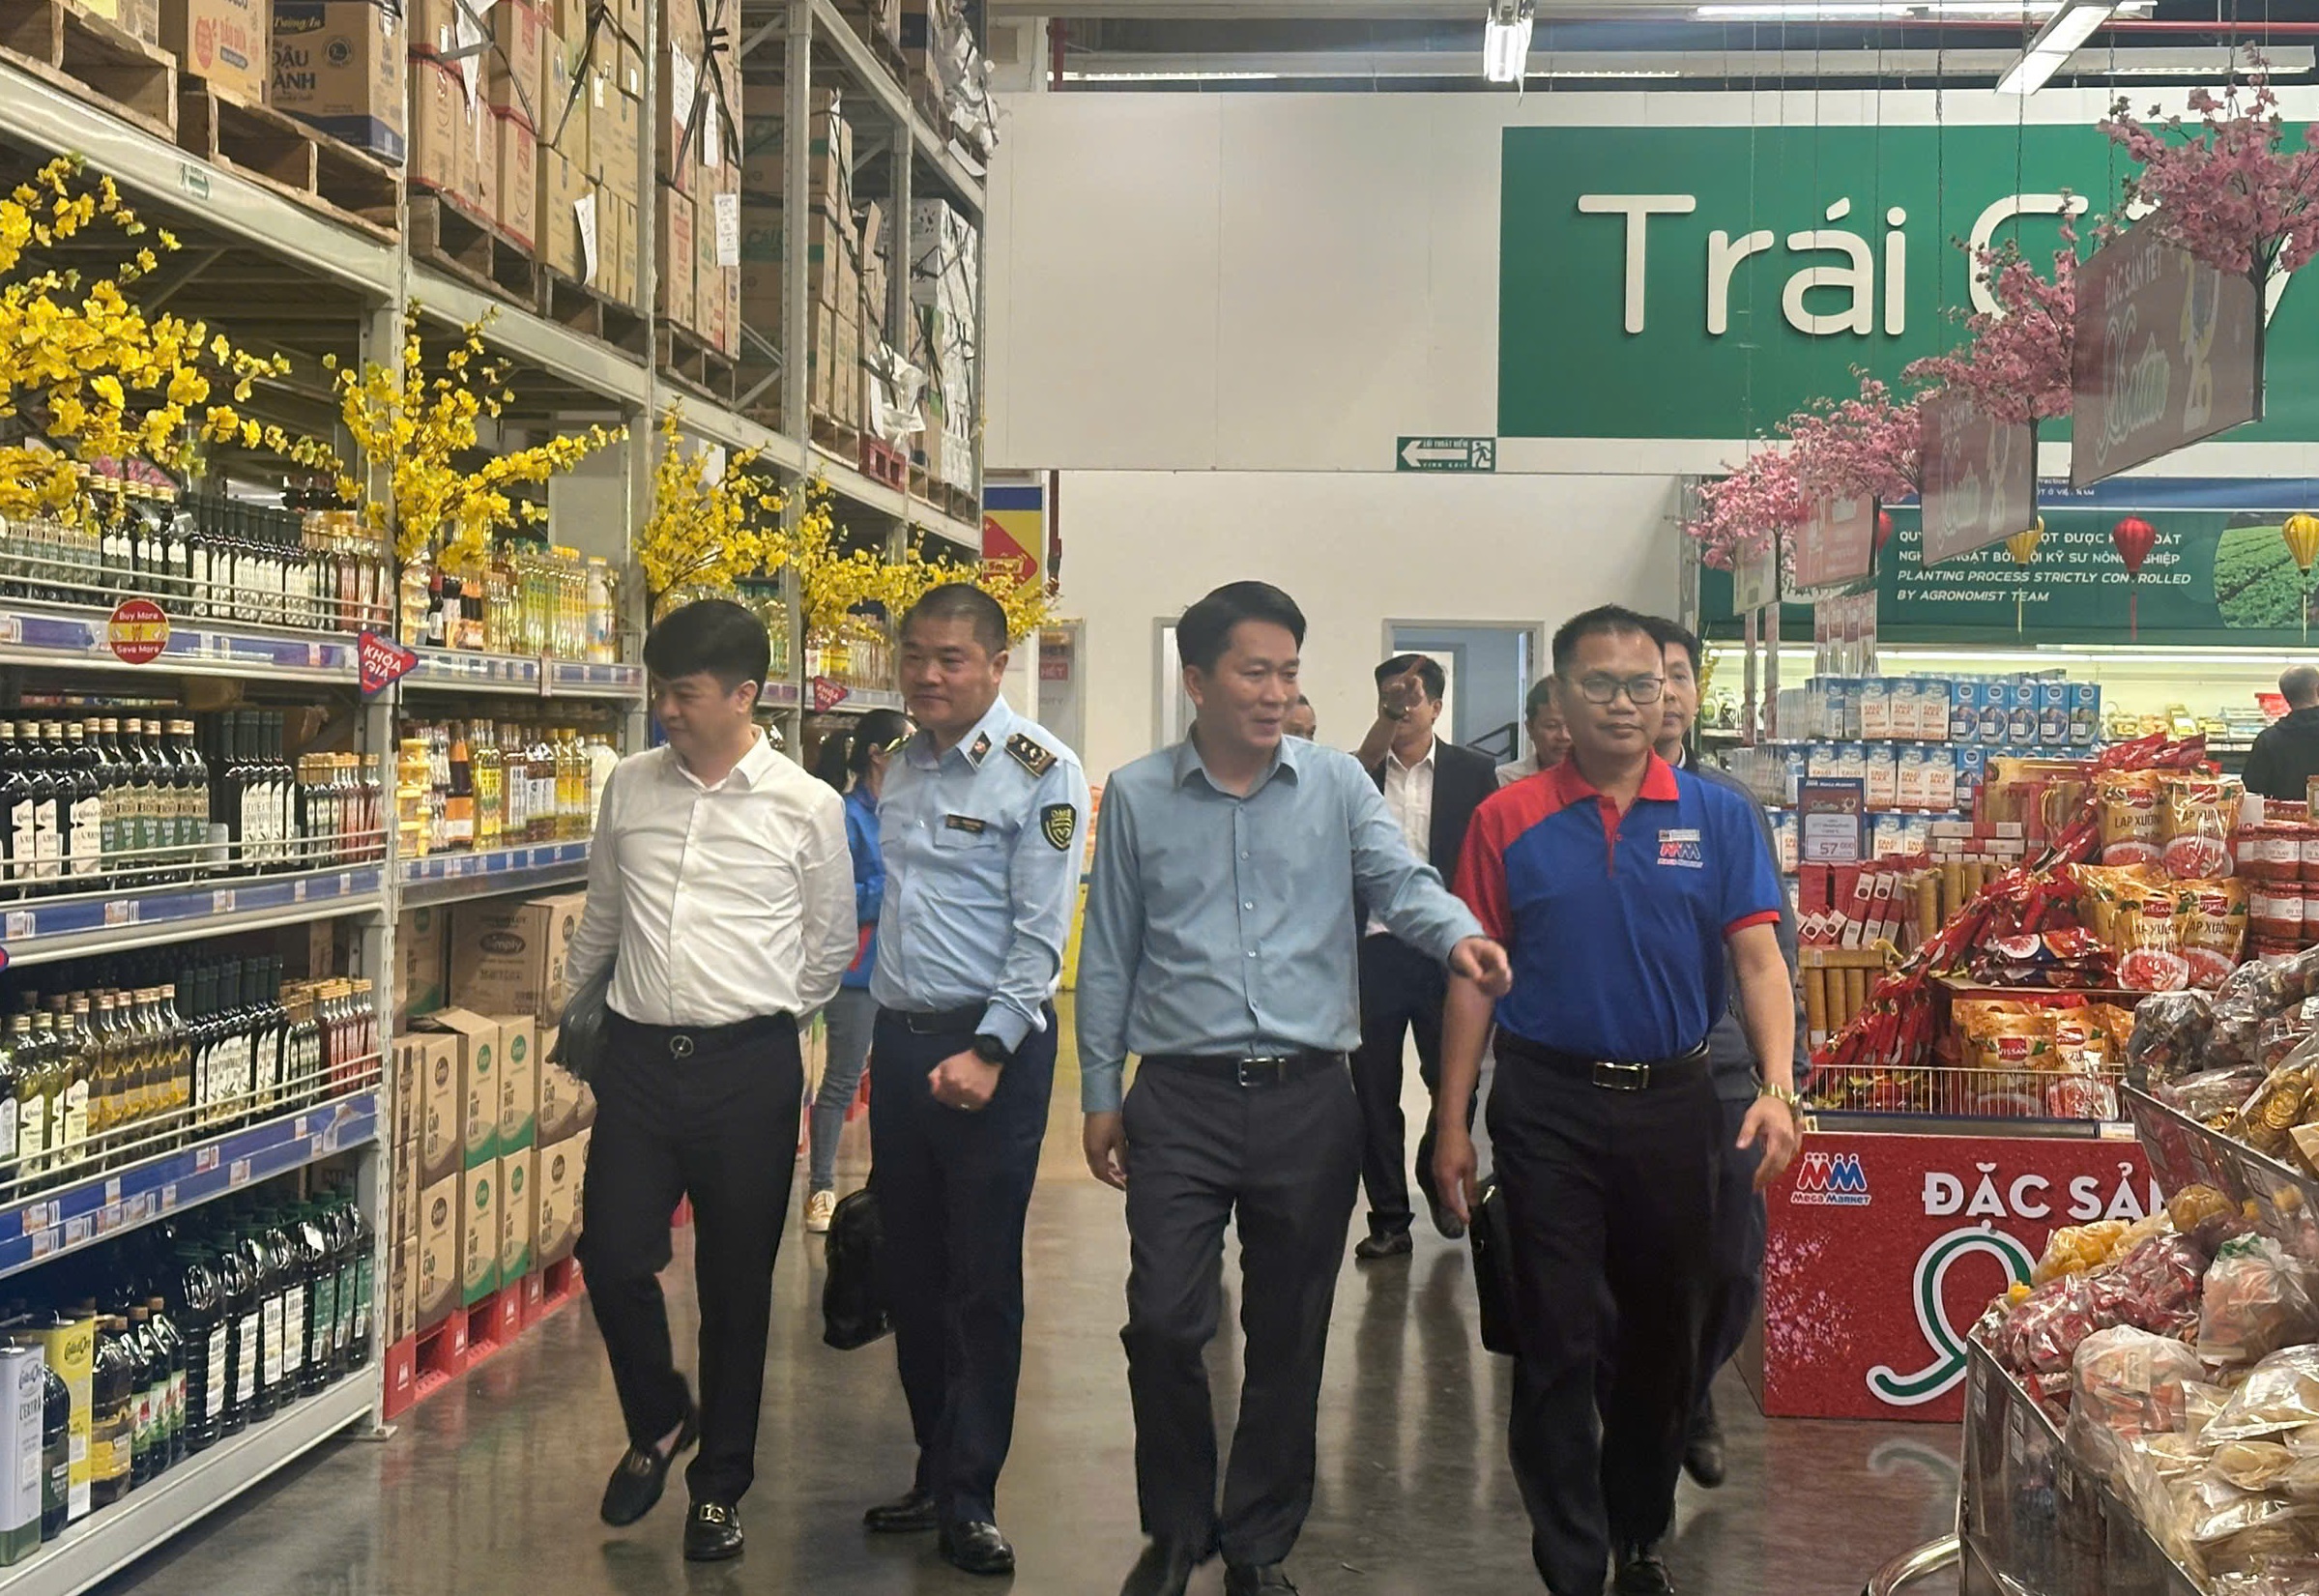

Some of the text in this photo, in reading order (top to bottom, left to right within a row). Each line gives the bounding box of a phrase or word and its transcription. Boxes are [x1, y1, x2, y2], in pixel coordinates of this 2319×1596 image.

[1577, 194, 1906, 335] Trái
[2142, 551, 2181, 567] GHIỆP
[1897, 569, 2191, 585] PLANTING PROCESS STRICTLY CONROLLED
[1897, 590, 2050, 602] BY AGRONOMIST TEAM
[119, 611, 135, 622] Buy
[1922, 1162, 2051, 1231] ĐẶC
